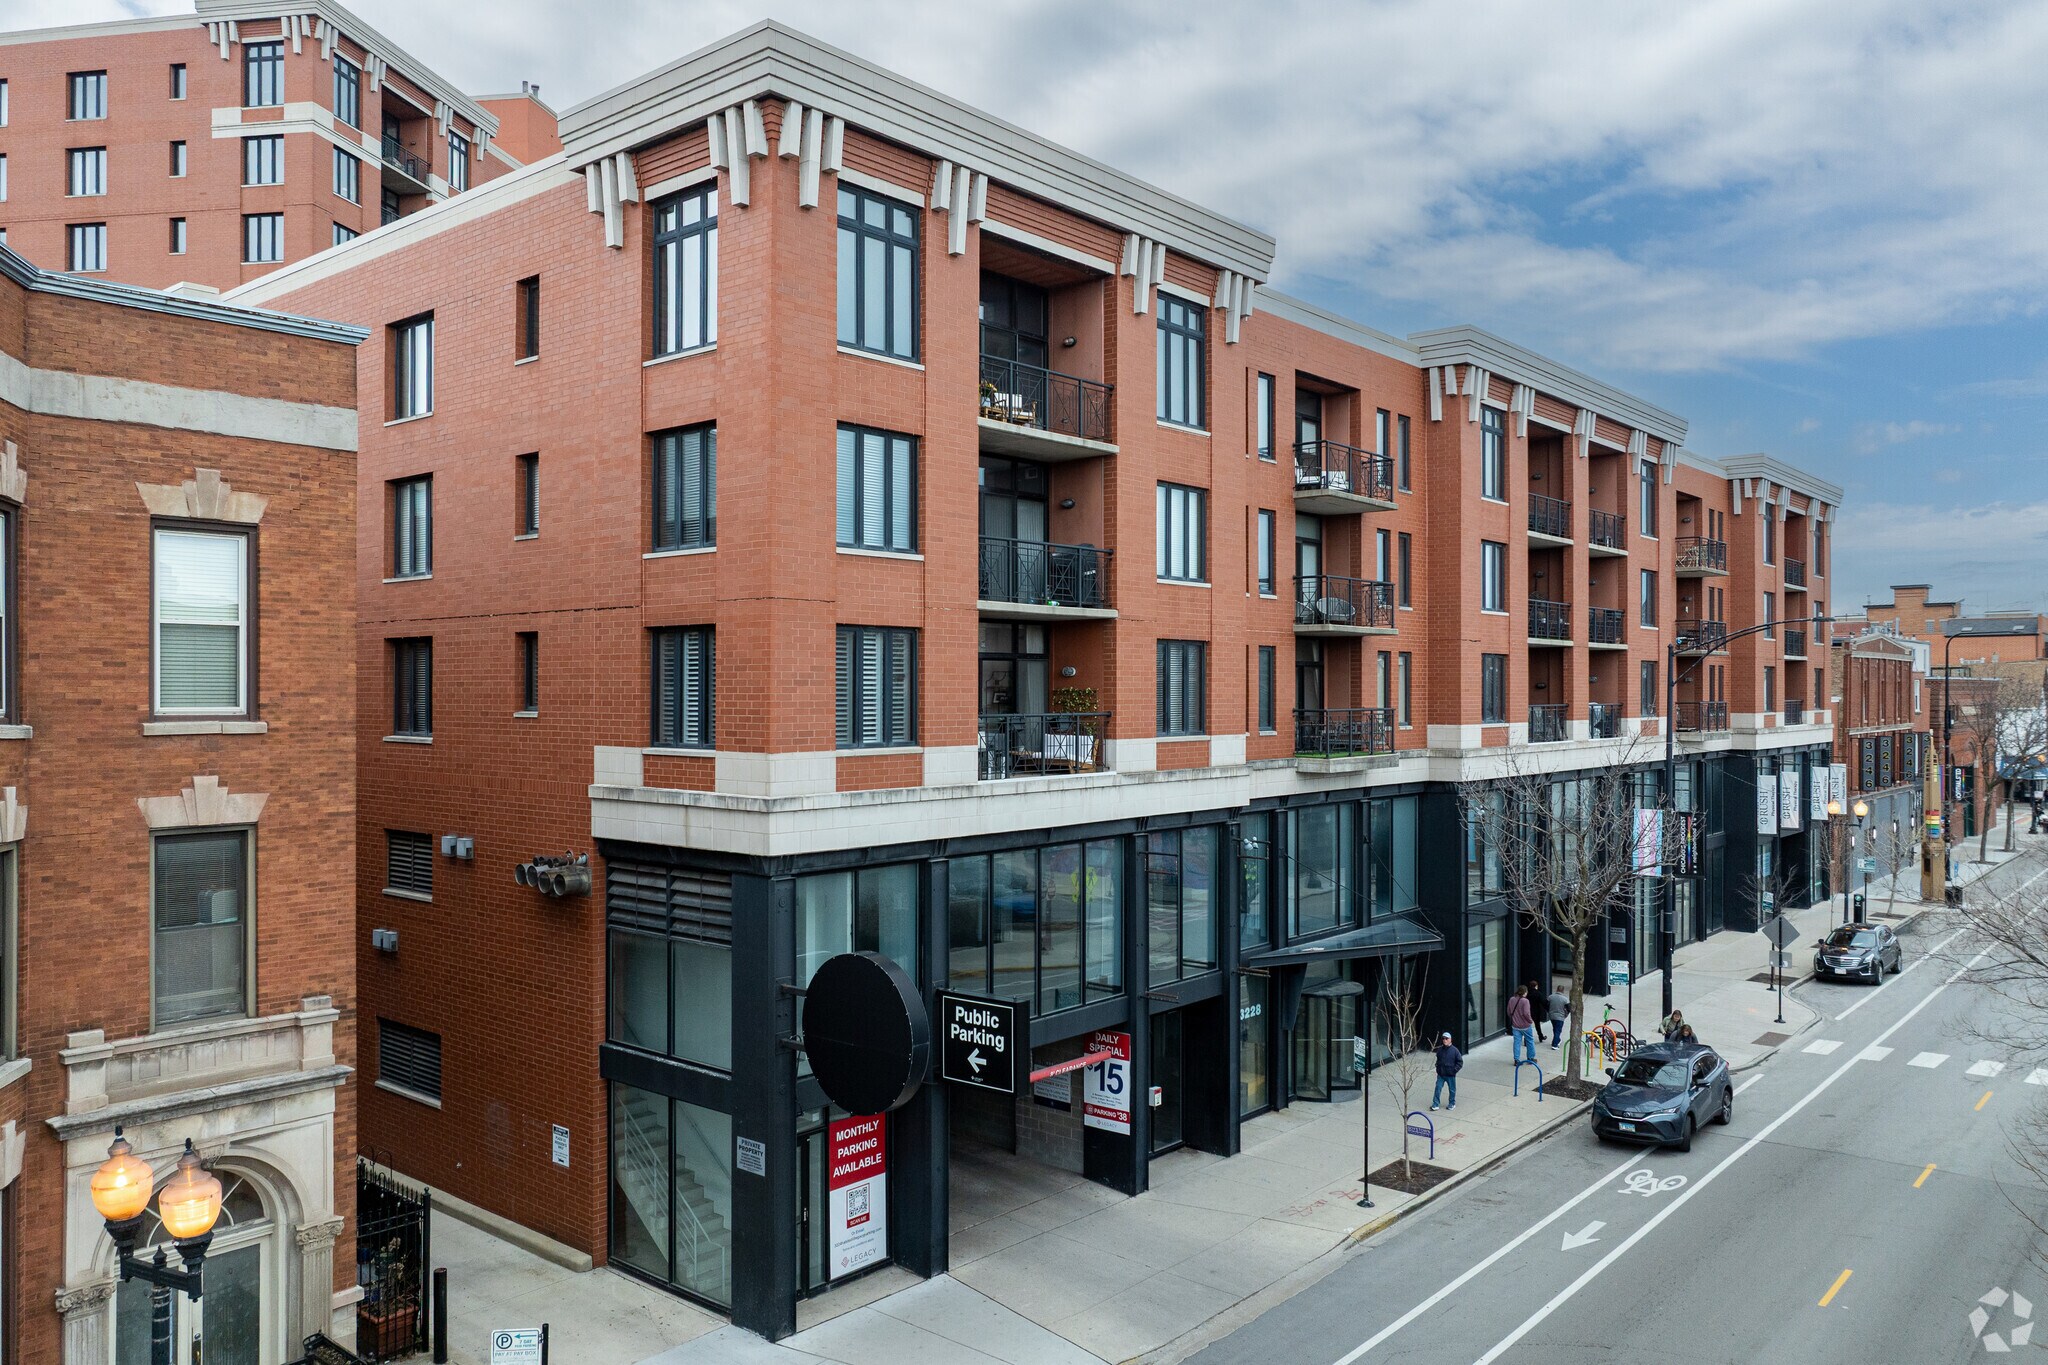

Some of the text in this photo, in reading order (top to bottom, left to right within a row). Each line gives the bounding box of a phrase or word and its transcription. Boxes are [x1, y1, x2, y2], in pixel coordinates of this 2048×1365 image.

[1865, 741, 1873, 788] 3246
[1760, 791, 1768, 816] RUSH
[955, 1005, 1000, 1028] Public
[1240, 1004, 1261, 1020] 3228
[951, 1023, 1005, 1052] Parking
[1095, 1033, 1119, 1045] DAILY
[1089, 1042, 1125, 1057] SPECIAL
[1094, 1107, 1116, 1118] PARKING
[836, 1120, 879, 1142] MONTHLY
[738, 1144, 764, 1157] PROPERTY
[741, 1139, 761, 1150] PRIVATE
[837, 1137, 878, 1159] PARKING
[833, 1153, 882, 1178] AVAILABLE
[850, 1218, 860, 1226] SCAN
[850, 1248, 877, 1264] LEGACY
